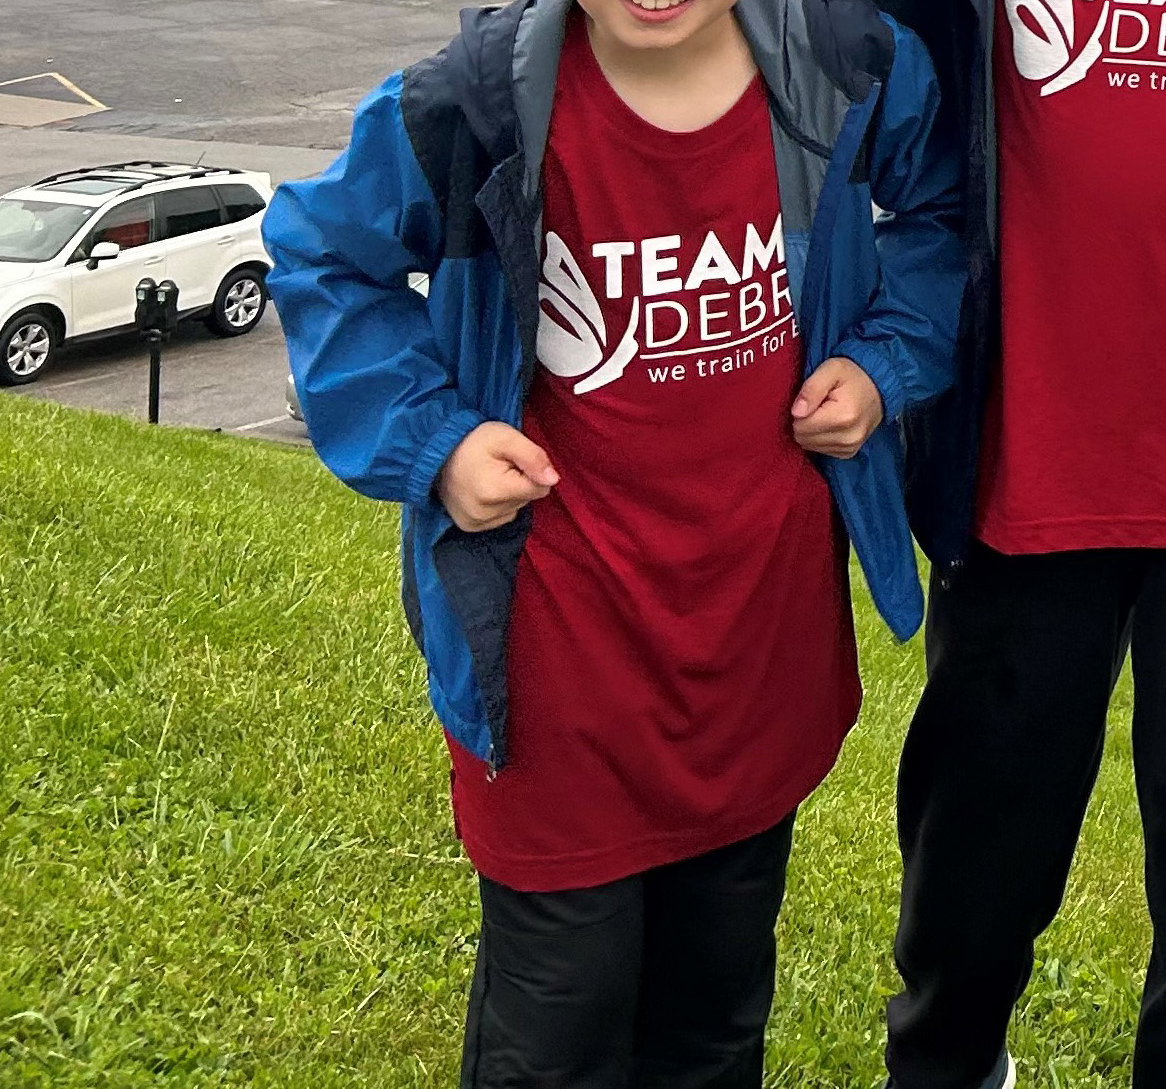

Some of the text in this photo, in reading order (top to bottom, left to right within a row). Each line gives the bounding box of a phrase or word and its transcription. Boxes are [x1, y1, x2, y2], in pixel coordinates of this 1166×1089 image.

[1108, 71, 1140, 89] we
[592, 213, 785, 298] TEAM
[648, 364, 686, 383] we
[697, 348, 754, 376] train
[762, 333, 786, 357] for
